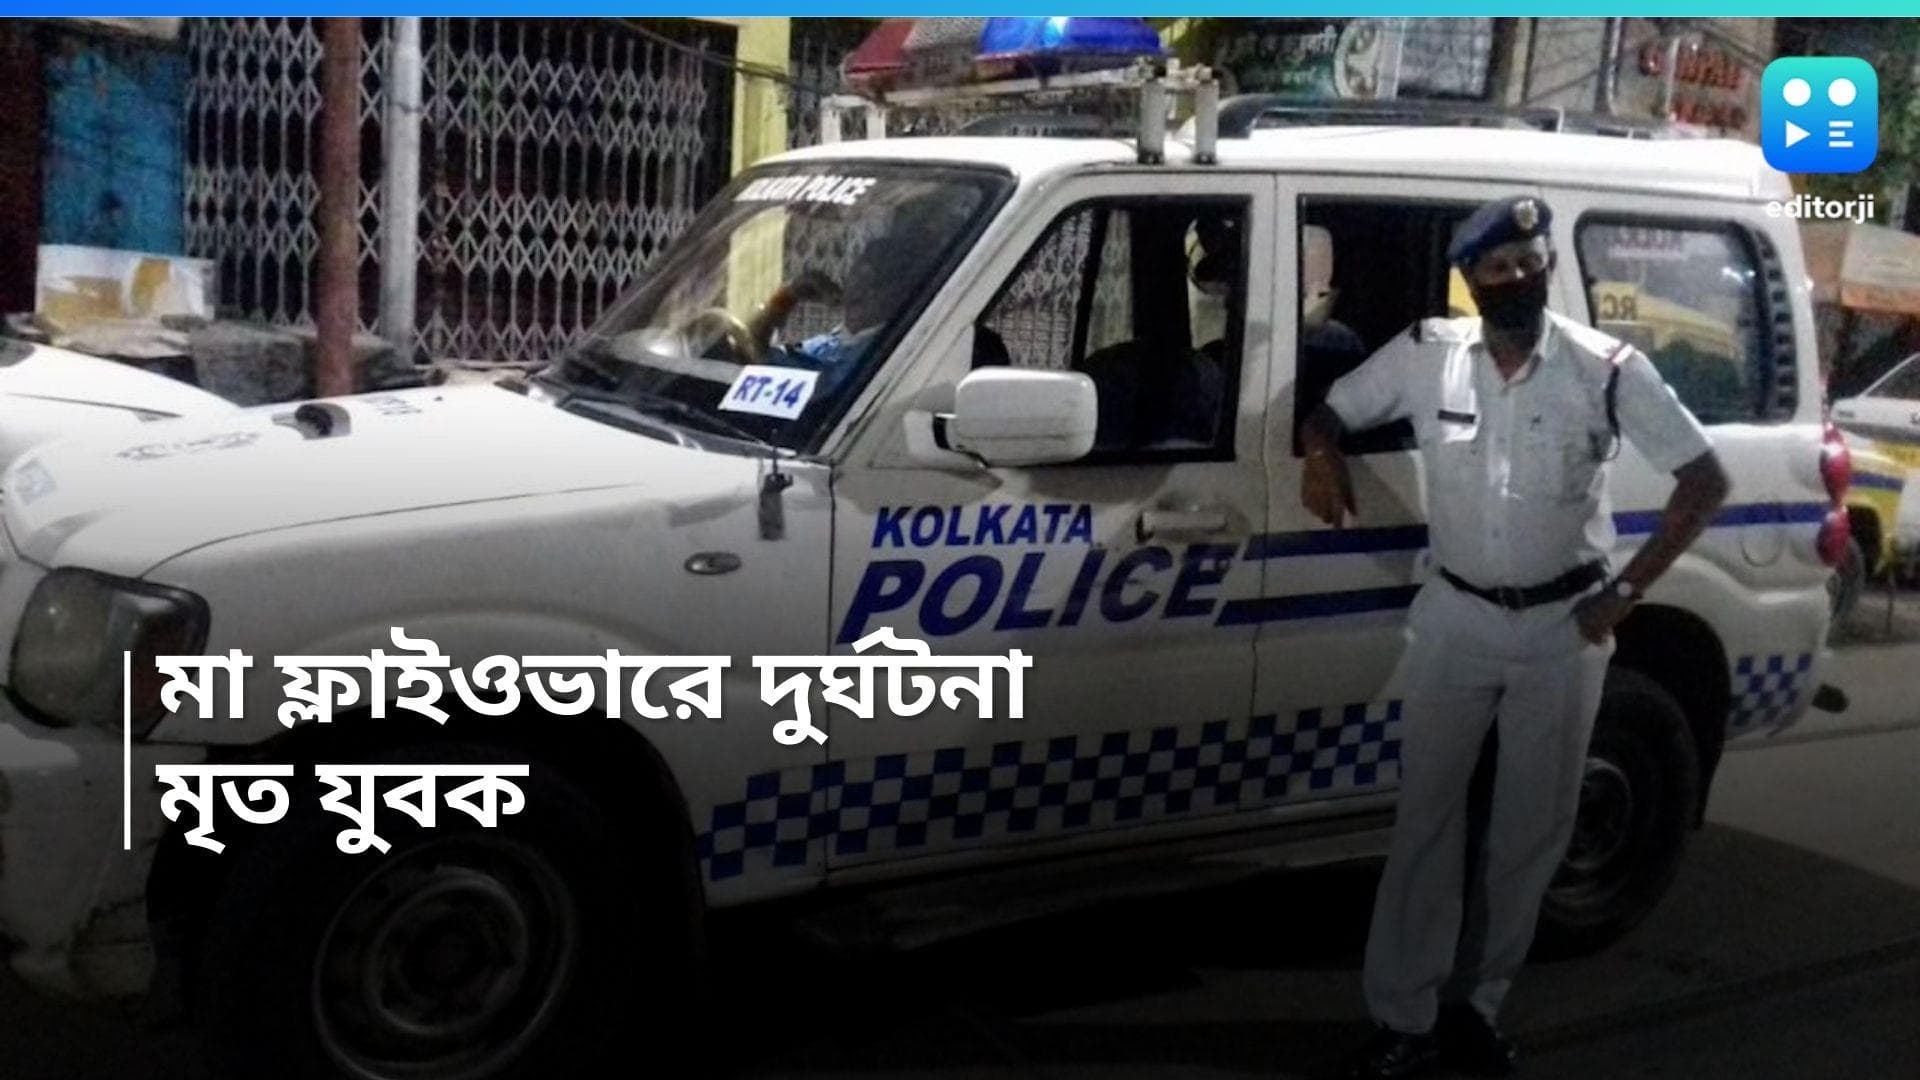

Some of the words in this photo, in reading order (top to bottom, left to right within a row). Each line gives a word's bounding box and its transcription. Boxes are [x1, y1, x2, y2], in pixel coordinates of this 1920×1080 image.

[796, 174, 877, 206] POLICE
[732, 374, 807, 409] RT-14
[871, 504, 1094, 548] KOLKATA
[835, 543, 1240, 646] POLICE
